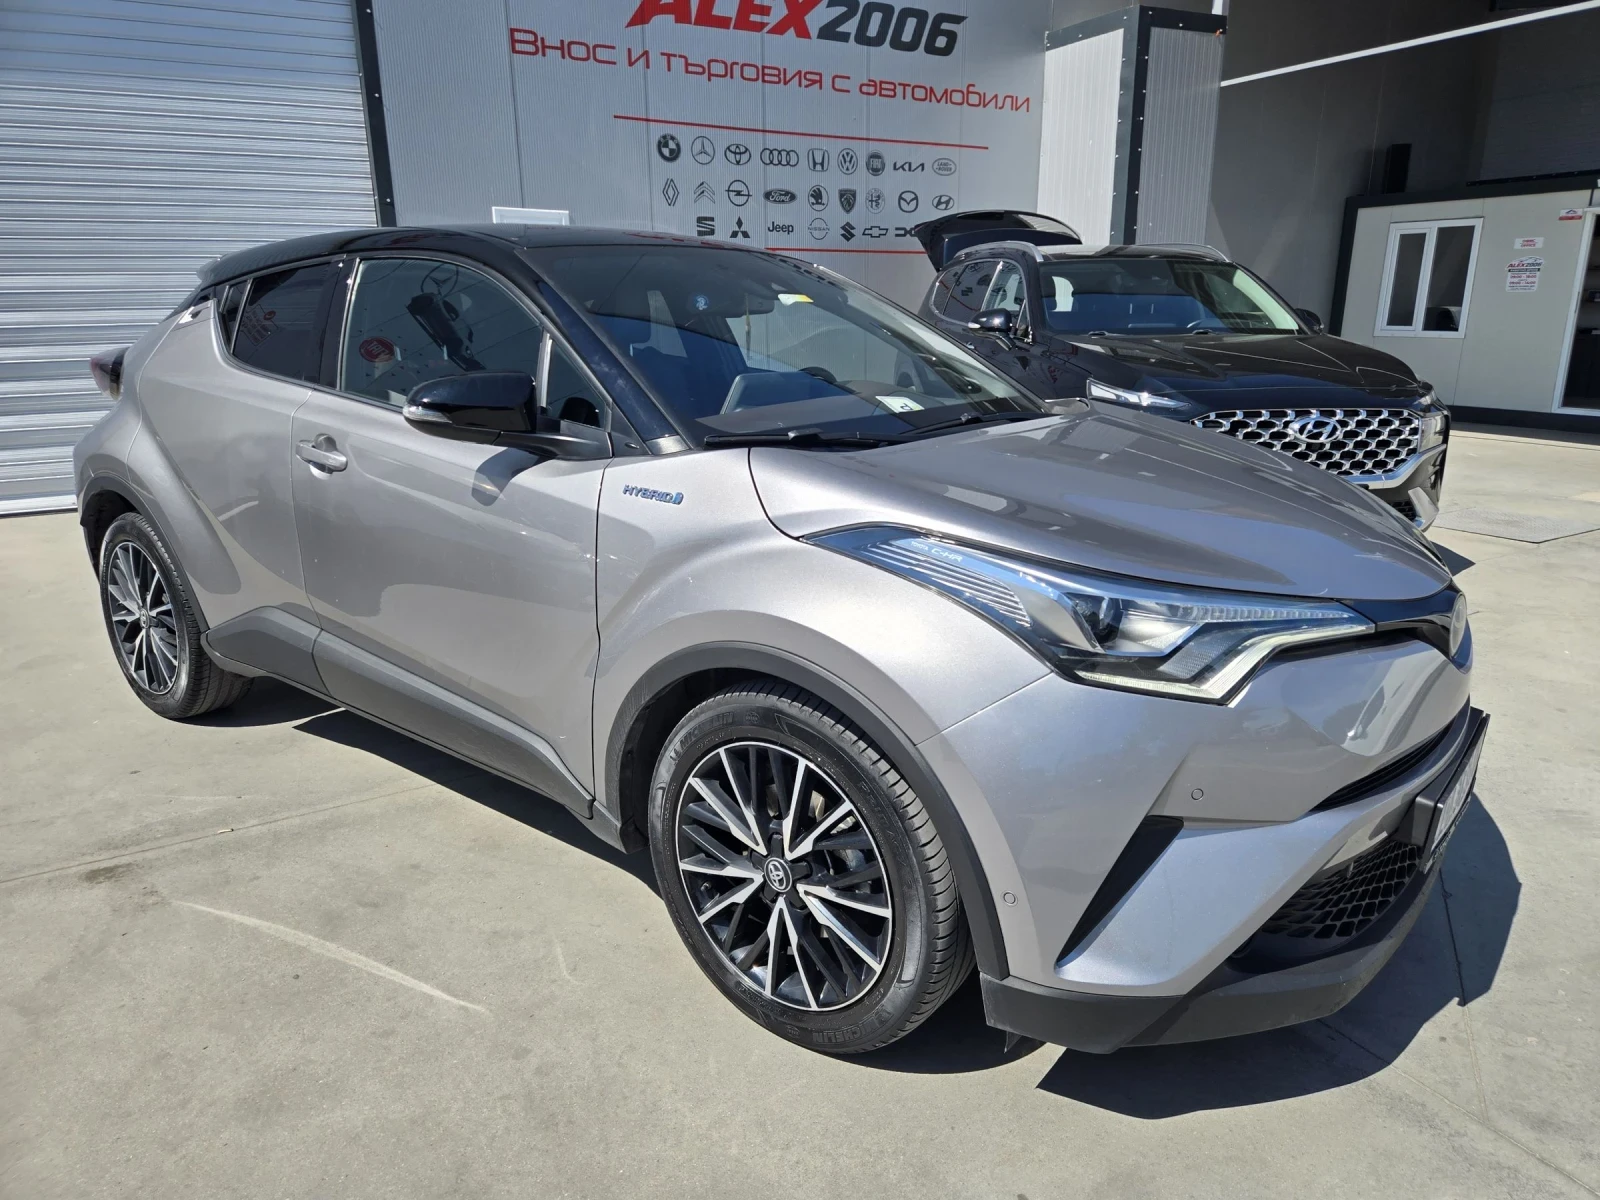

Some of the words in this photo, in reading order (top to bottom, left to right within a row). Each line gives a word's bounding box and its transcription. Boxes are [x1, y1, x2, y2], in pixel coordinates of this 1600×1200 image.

[625, 0, 968, 57] ALEX2006
[509, 27, 617, 65] Внос
[627, 47, 650, 69] и
[660, 52, 823, 90] търговия
[831, 74, 851, 93] с
[859, 78, 1030, 113] автомобили
[893, 161, 925, 172] KIA
[769, 190, 791, 202] Ford
[768, 221, 794, 235] Jeep
[622, 484, 674, 504] HYBRID
